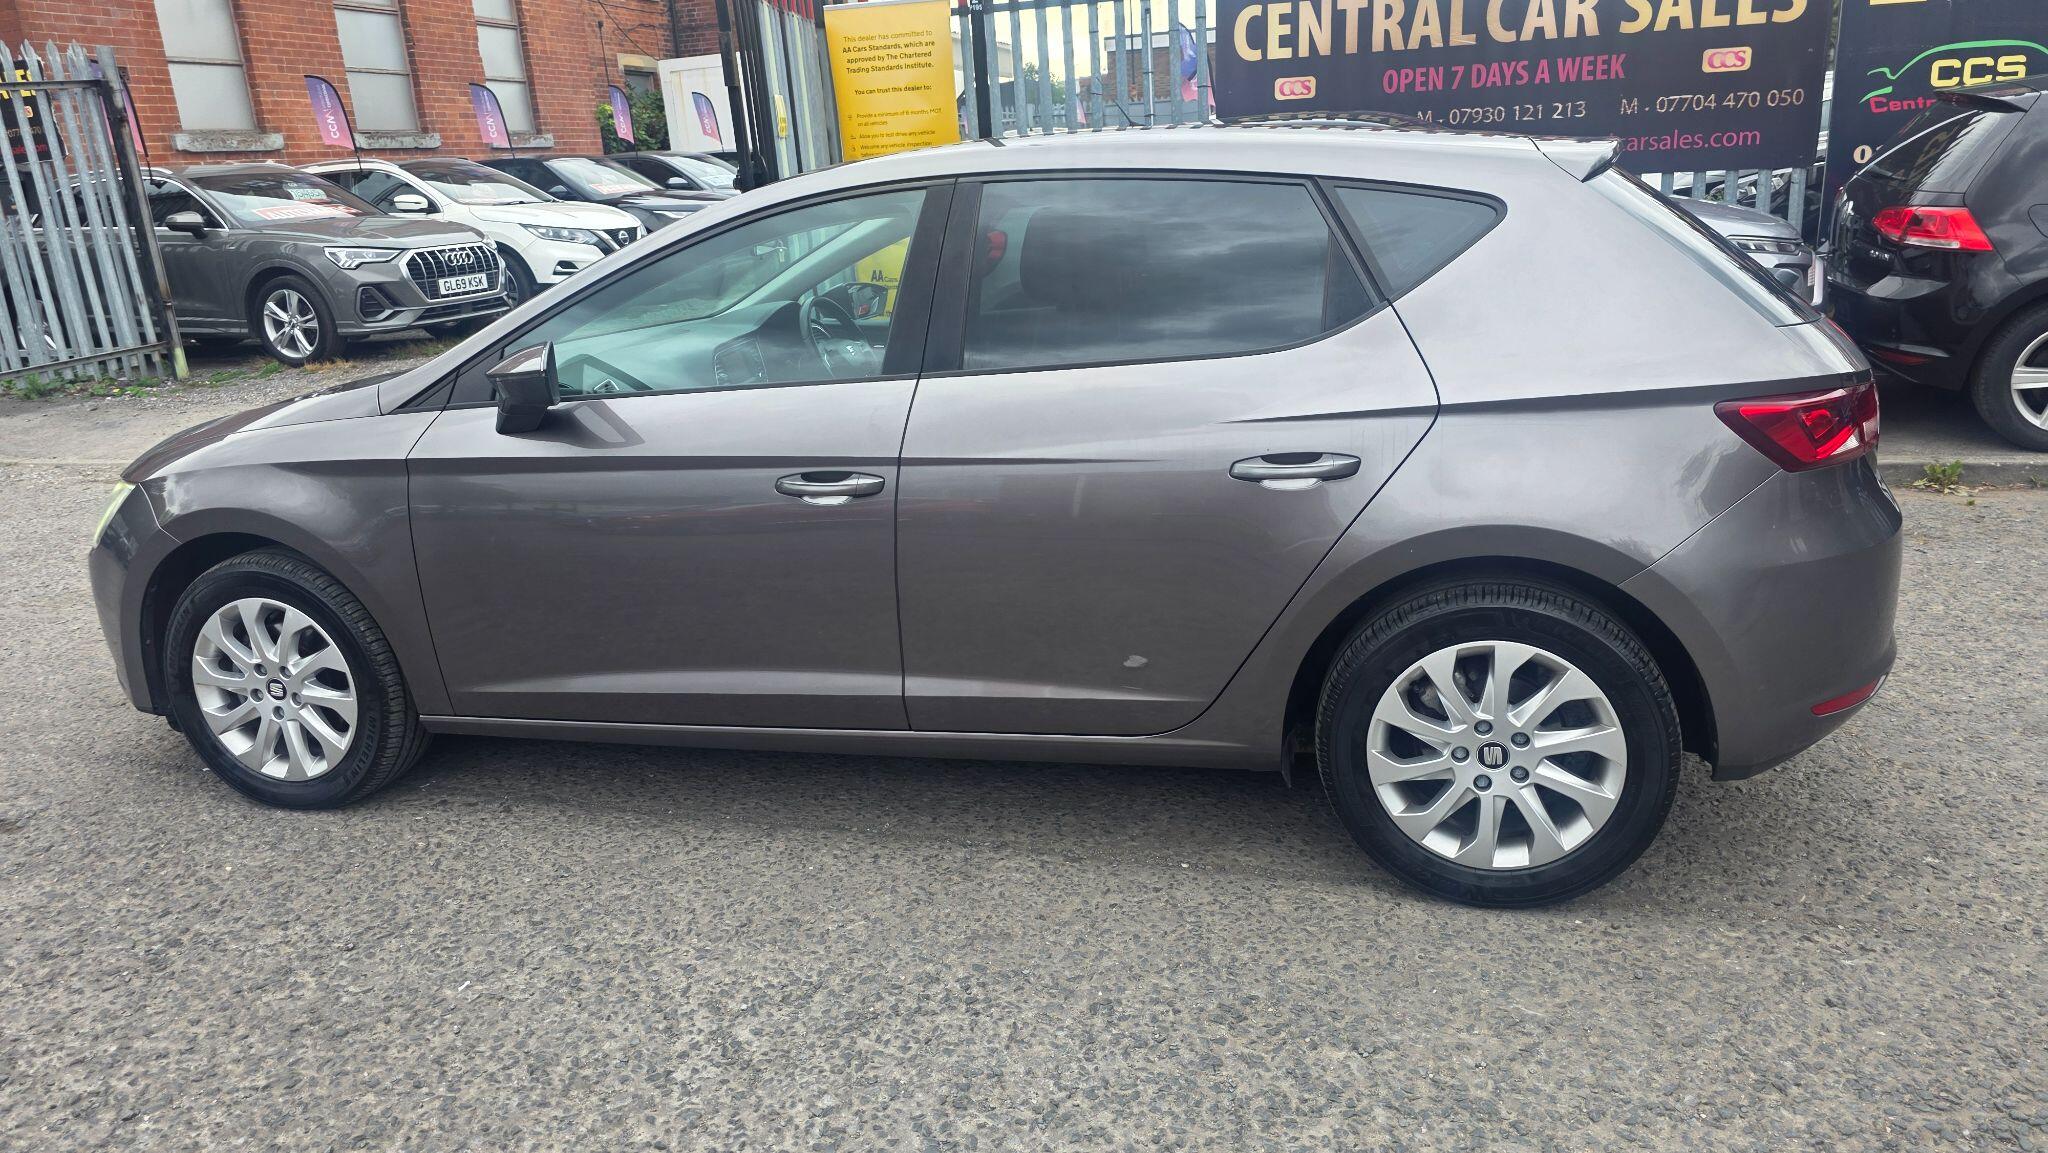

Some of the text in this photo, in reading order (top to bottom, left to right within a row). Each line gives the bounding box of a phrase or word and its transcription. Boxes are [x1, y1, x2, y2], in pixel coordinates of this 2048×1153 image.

[890, 30, 925, 39] committed
[1234, 0, 1477, 61] CENTRAL
[1486, 0, 1600, 42] CAR
[853, 45, 867, 53] Cars
[868, 43, 903, 52] Standards,
[904, 40, 924, 49] which
[846, 54, 876, 64] approved
[877, 54, 885, 62] by
[899, 51, 932, 59] Chartered
[1707, 49, 1747, 69] CCS
[846, 61, 934, 75] Trading Standards Institute.
[1383, 53, 1627, 94] OPEN 7 DAYS A WEEK
[1930, 54, 2027, 88] CCS
[854, 88, 865, 96] You
[1278, 79, 1312, 97] CCS
[1620, 97, 1638, 115] M
[1656, 93, 1716, 113] 07704
[1722, 91, 1761, 109] 470
[1767, 88, 1805, 107] 050
[1870, 96, 1937, 113] Centr
[1416, 110, 1433, 124] M
[1449, 106, 1505, 125] 07930
[1513, 104, 1543, 121] 121
[1552, 101, 1587, 119] 213
[444, 275, 484, 291] GL69 KSK
[871, 269, 884, 282] AA
